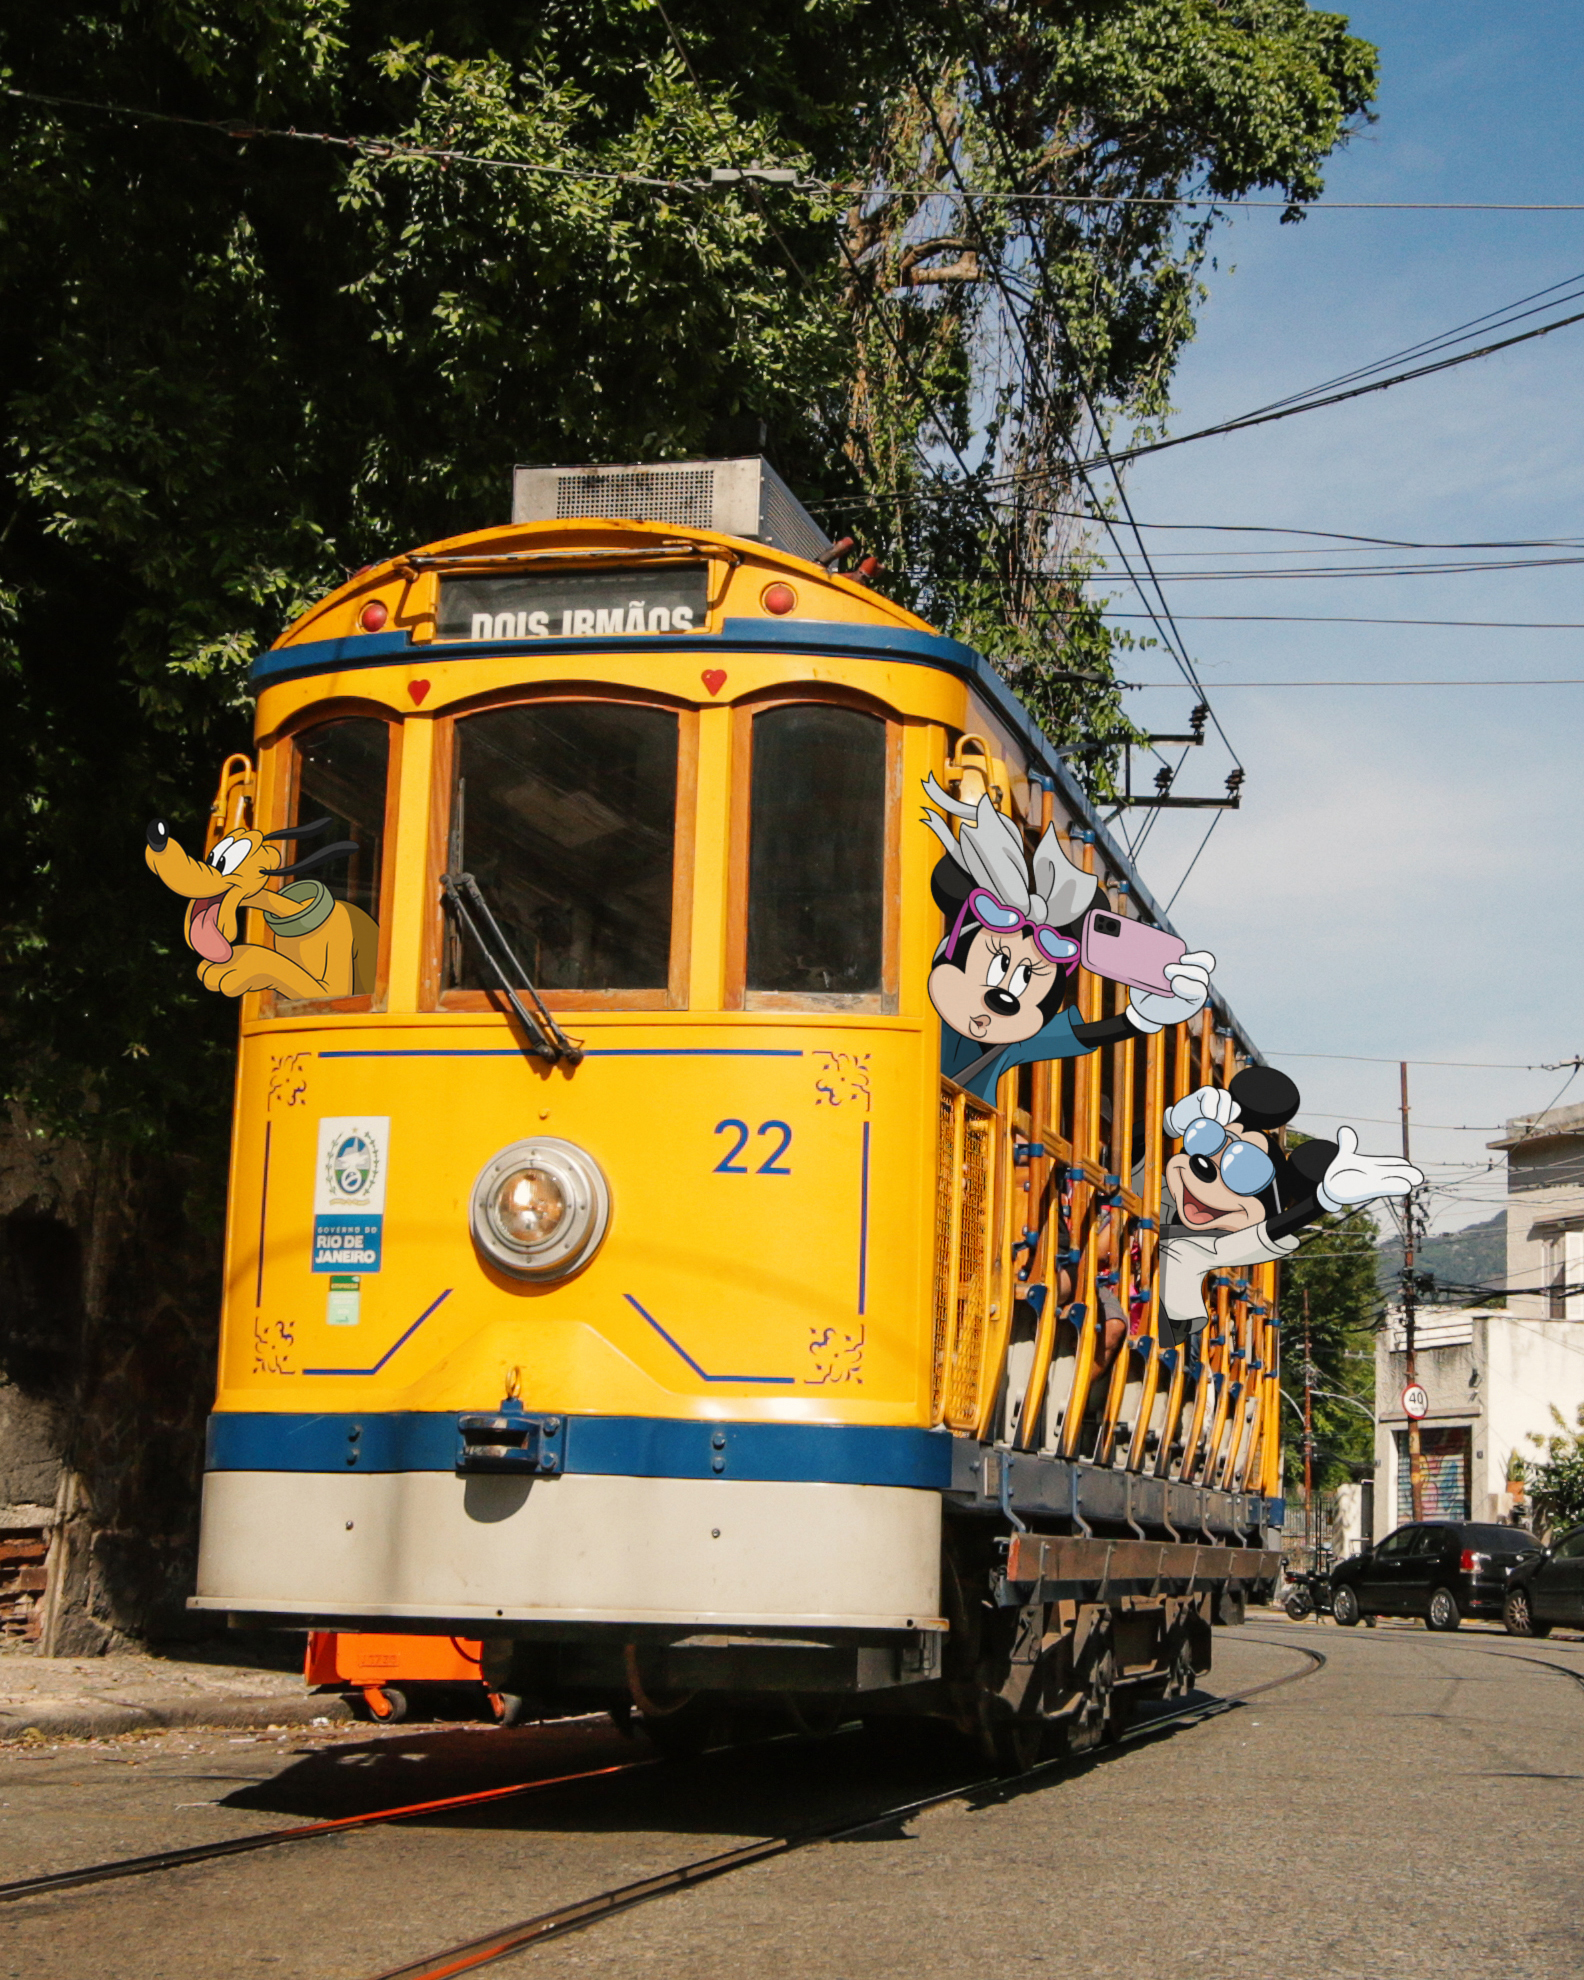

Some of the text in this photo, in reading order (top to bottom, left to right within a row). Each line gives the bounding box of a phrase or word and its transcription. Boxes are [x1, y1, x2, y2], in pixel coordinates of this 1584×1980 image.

[472, 600, 694, 639] DOIS IRMÃOS
[713, 1118, 792, 1175] 22
[316, 1235, 364, 1249] RIO DE
[315, 1249, 376, 1264] JANEIRO
[1409, 1392, 1423, 1404] 40
